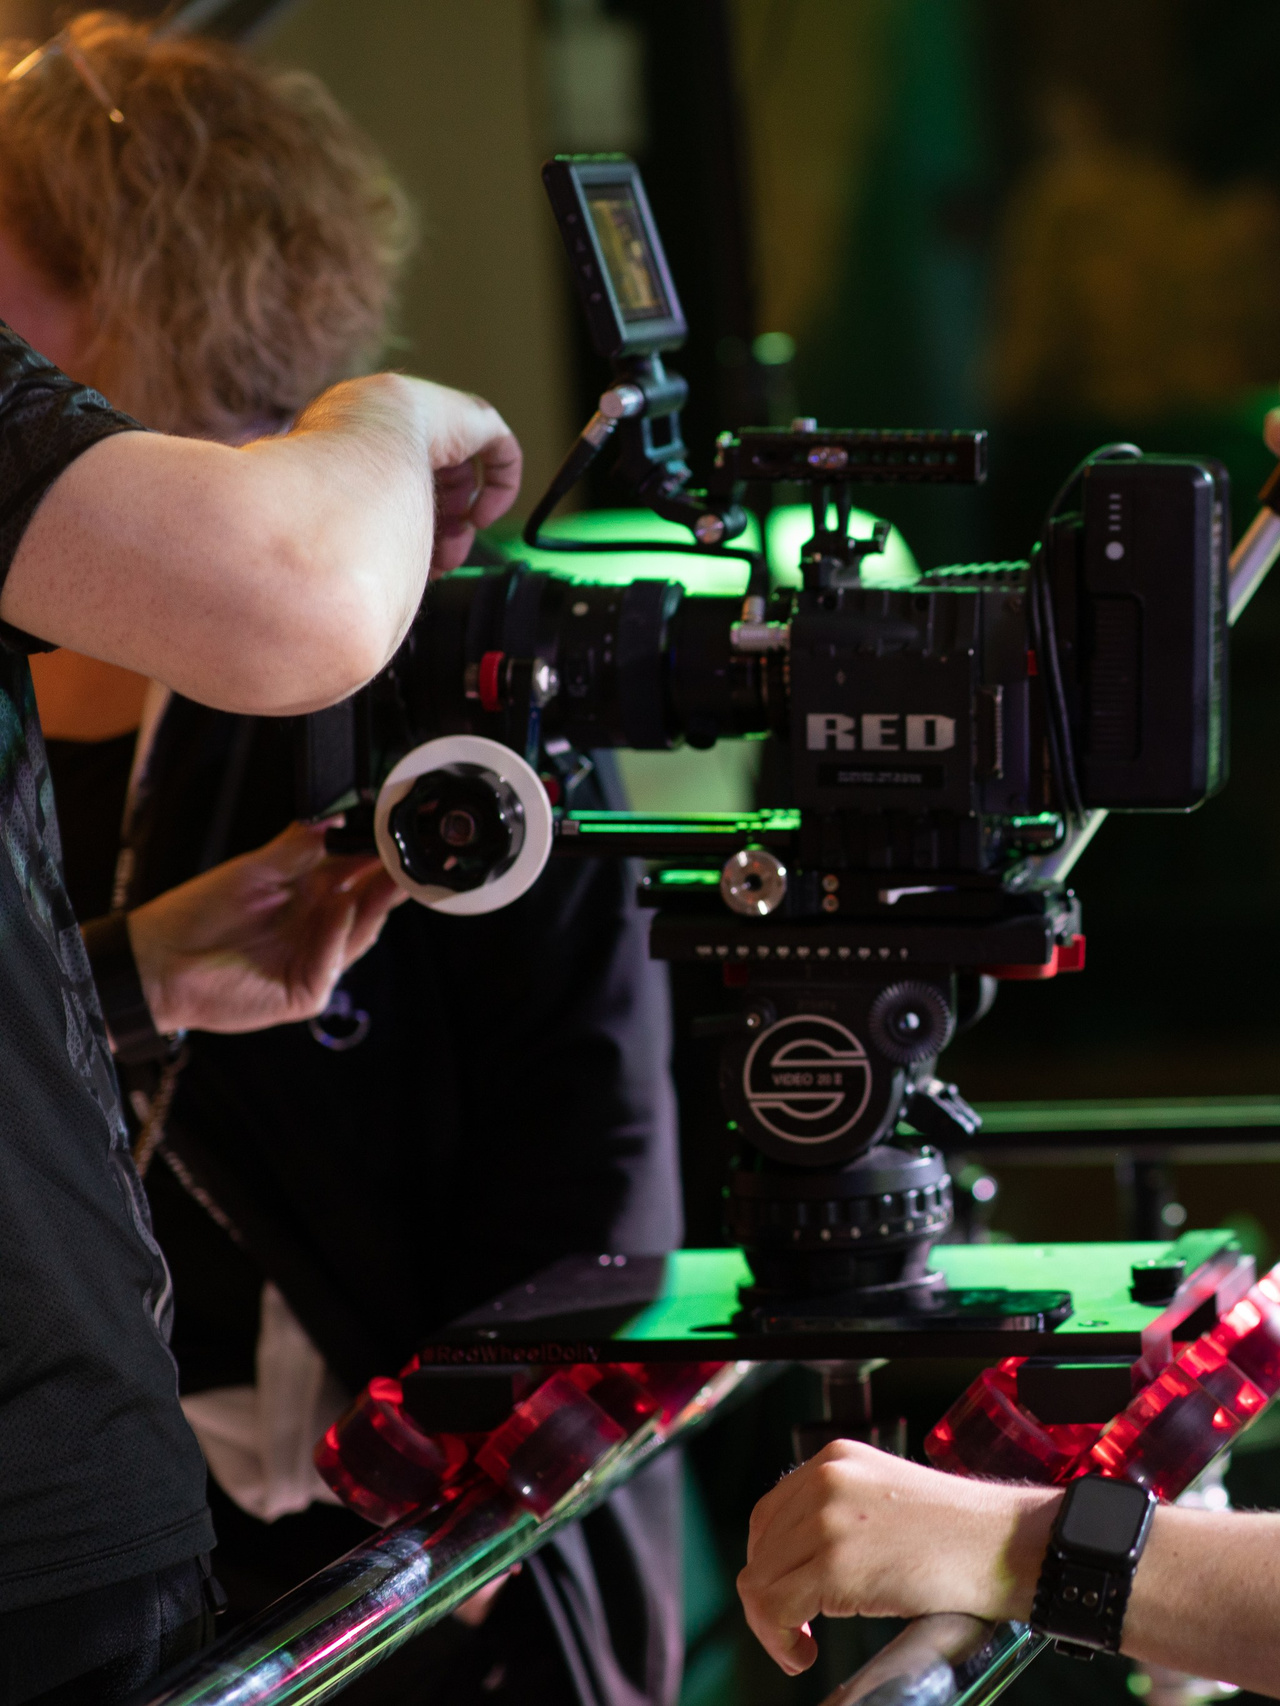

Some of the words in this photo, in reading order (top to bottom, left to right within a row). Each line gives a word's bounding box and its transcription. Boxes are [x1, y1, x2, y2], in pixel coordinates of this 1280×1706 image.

[806, 713, 956, 751] RED
[771, 1072, 815, 1086] VIDEO
[816, 1072, 833, 1086] 20
[421, 1342, 601, 1363] #RedWheelDolly
